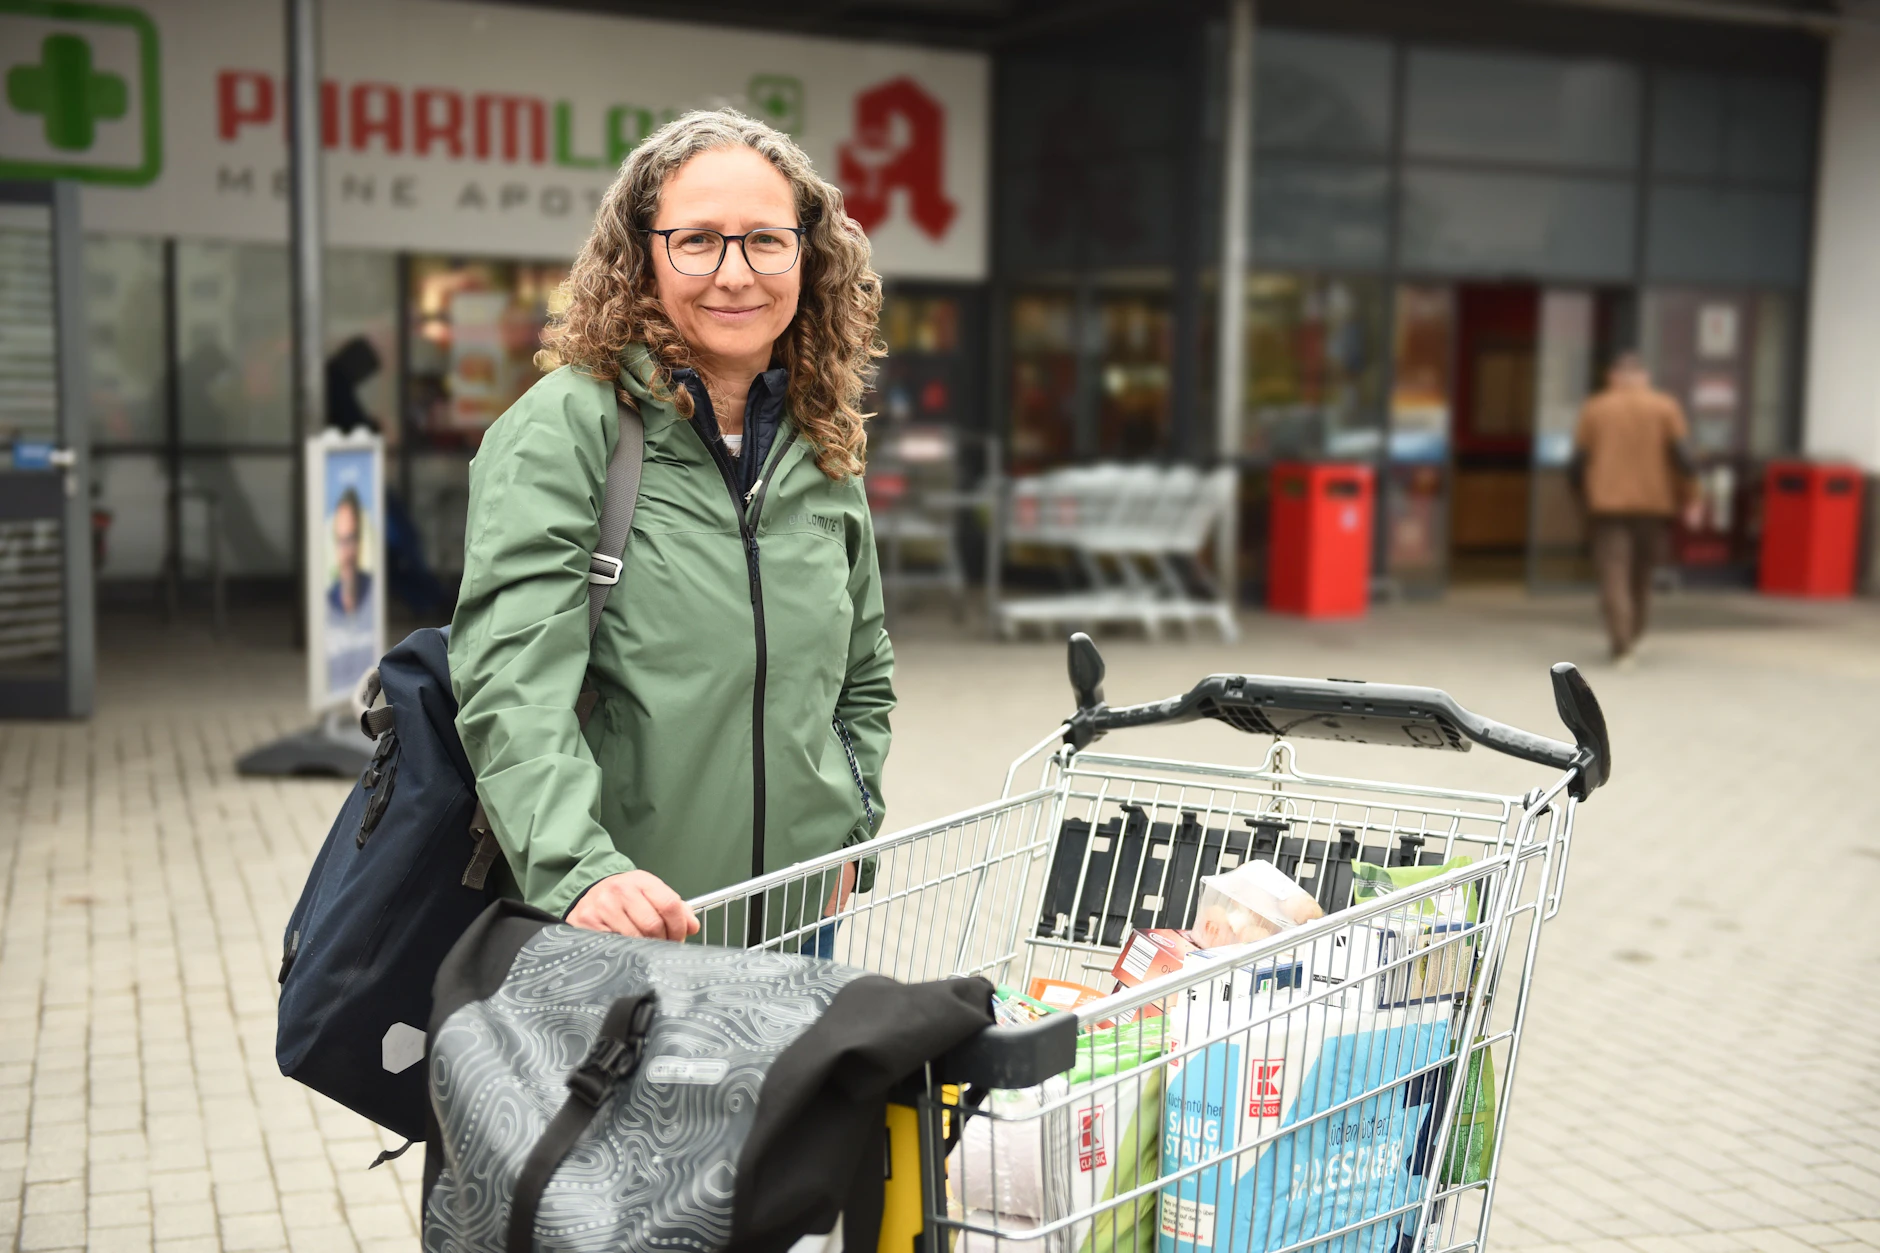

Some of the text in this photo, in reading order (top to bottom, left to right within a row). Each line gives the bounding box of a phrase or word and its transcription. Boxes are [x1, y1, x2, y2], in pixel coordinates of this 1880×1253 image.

[216, 166, 419, 208] MENE
[1251, 1104, 1280, 1116] CLASSI
[1169, 1111, 1218, 1143] SAUG
[1080, 1153, 1105, 1171] CLASIC
